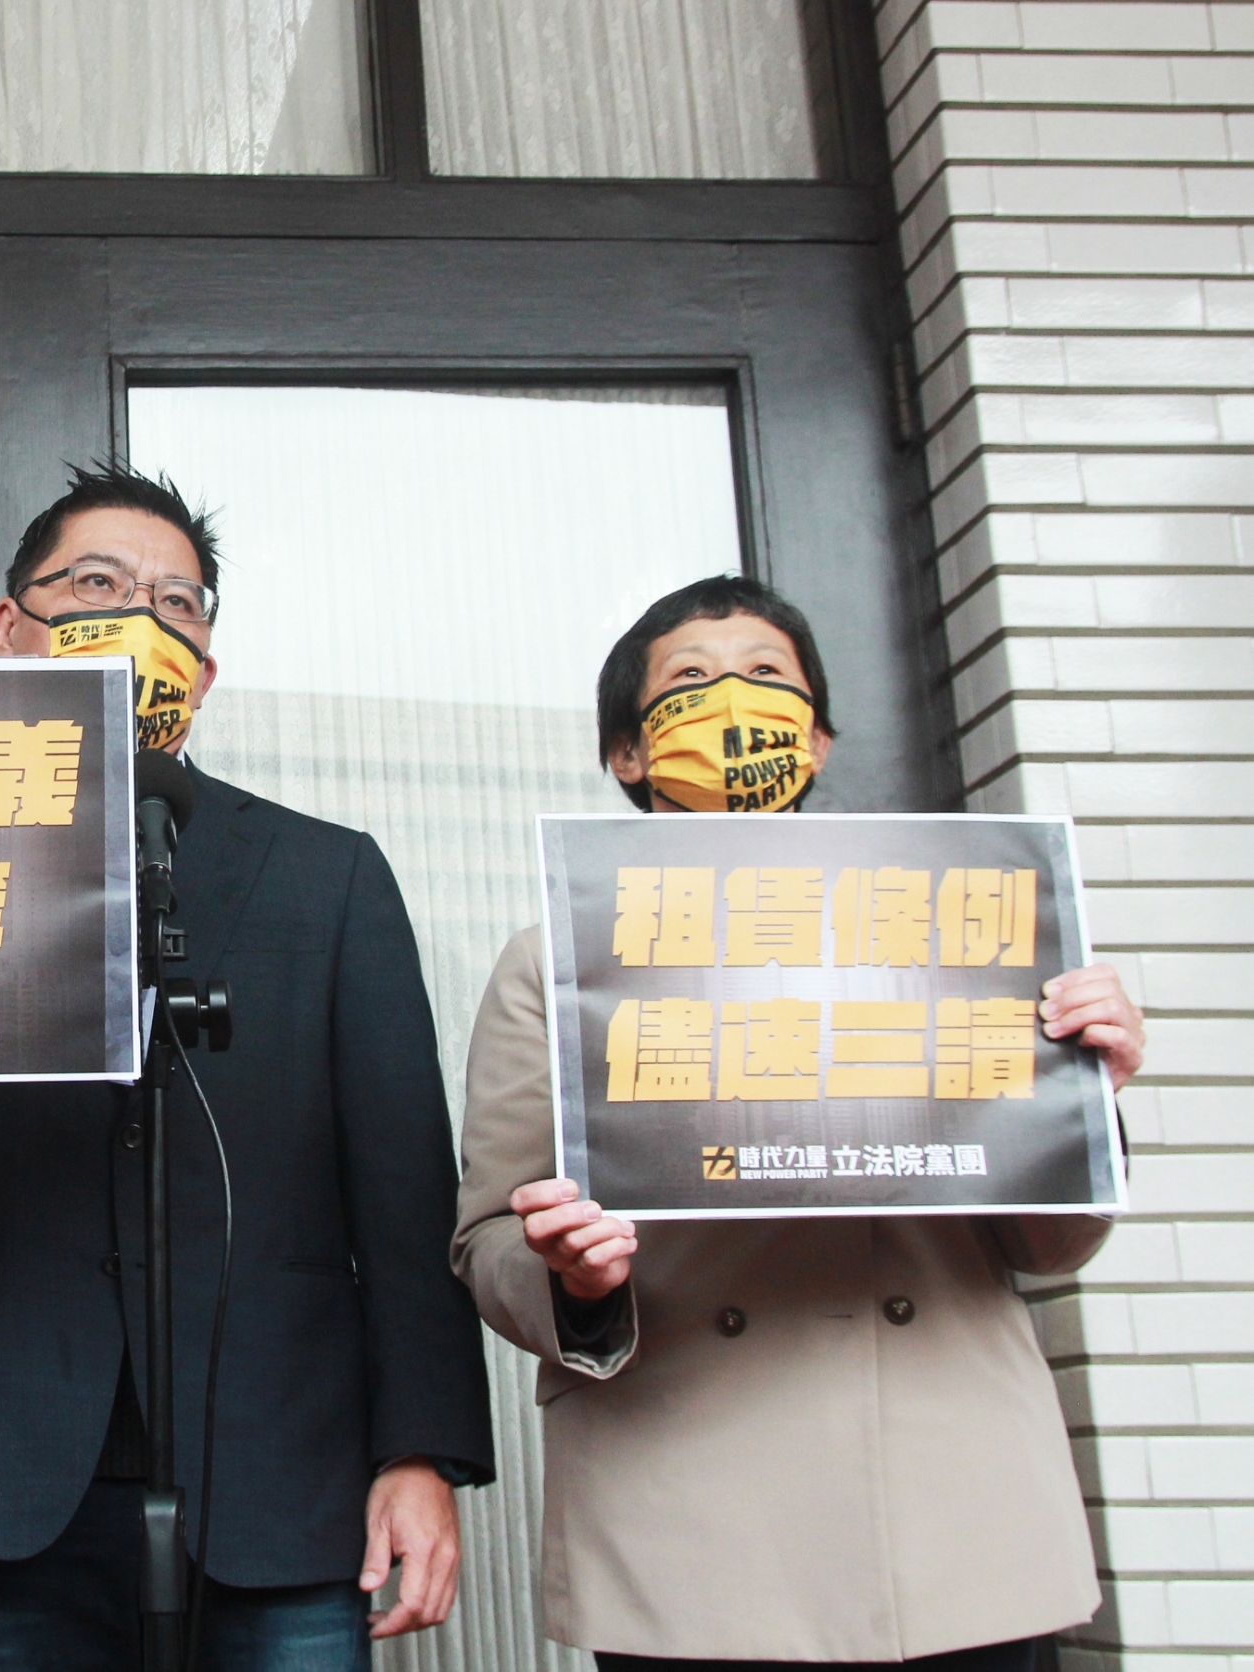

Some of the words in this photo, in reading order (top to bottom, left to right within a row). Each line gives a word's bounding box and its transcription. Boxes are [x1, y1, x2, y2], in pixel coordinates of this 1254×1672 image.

[722, 725, 797, 759] NEW
[724, 754, 799, 790] POWER
[726, 770, 797, 812] PARTY
[612, 866, 1037, 968] 租賃條例
[605, 997, 1036, 1103] 儘速三讀
[738, 1145, 828, 1168] 時代力量
[831, 1143, 988, 1177] 立法院黨團
[739, 1169, 763, 1180] NEW
[763, 1169, 797, 1180] POWER
[797, 1169, 828, 1180] PARTY
